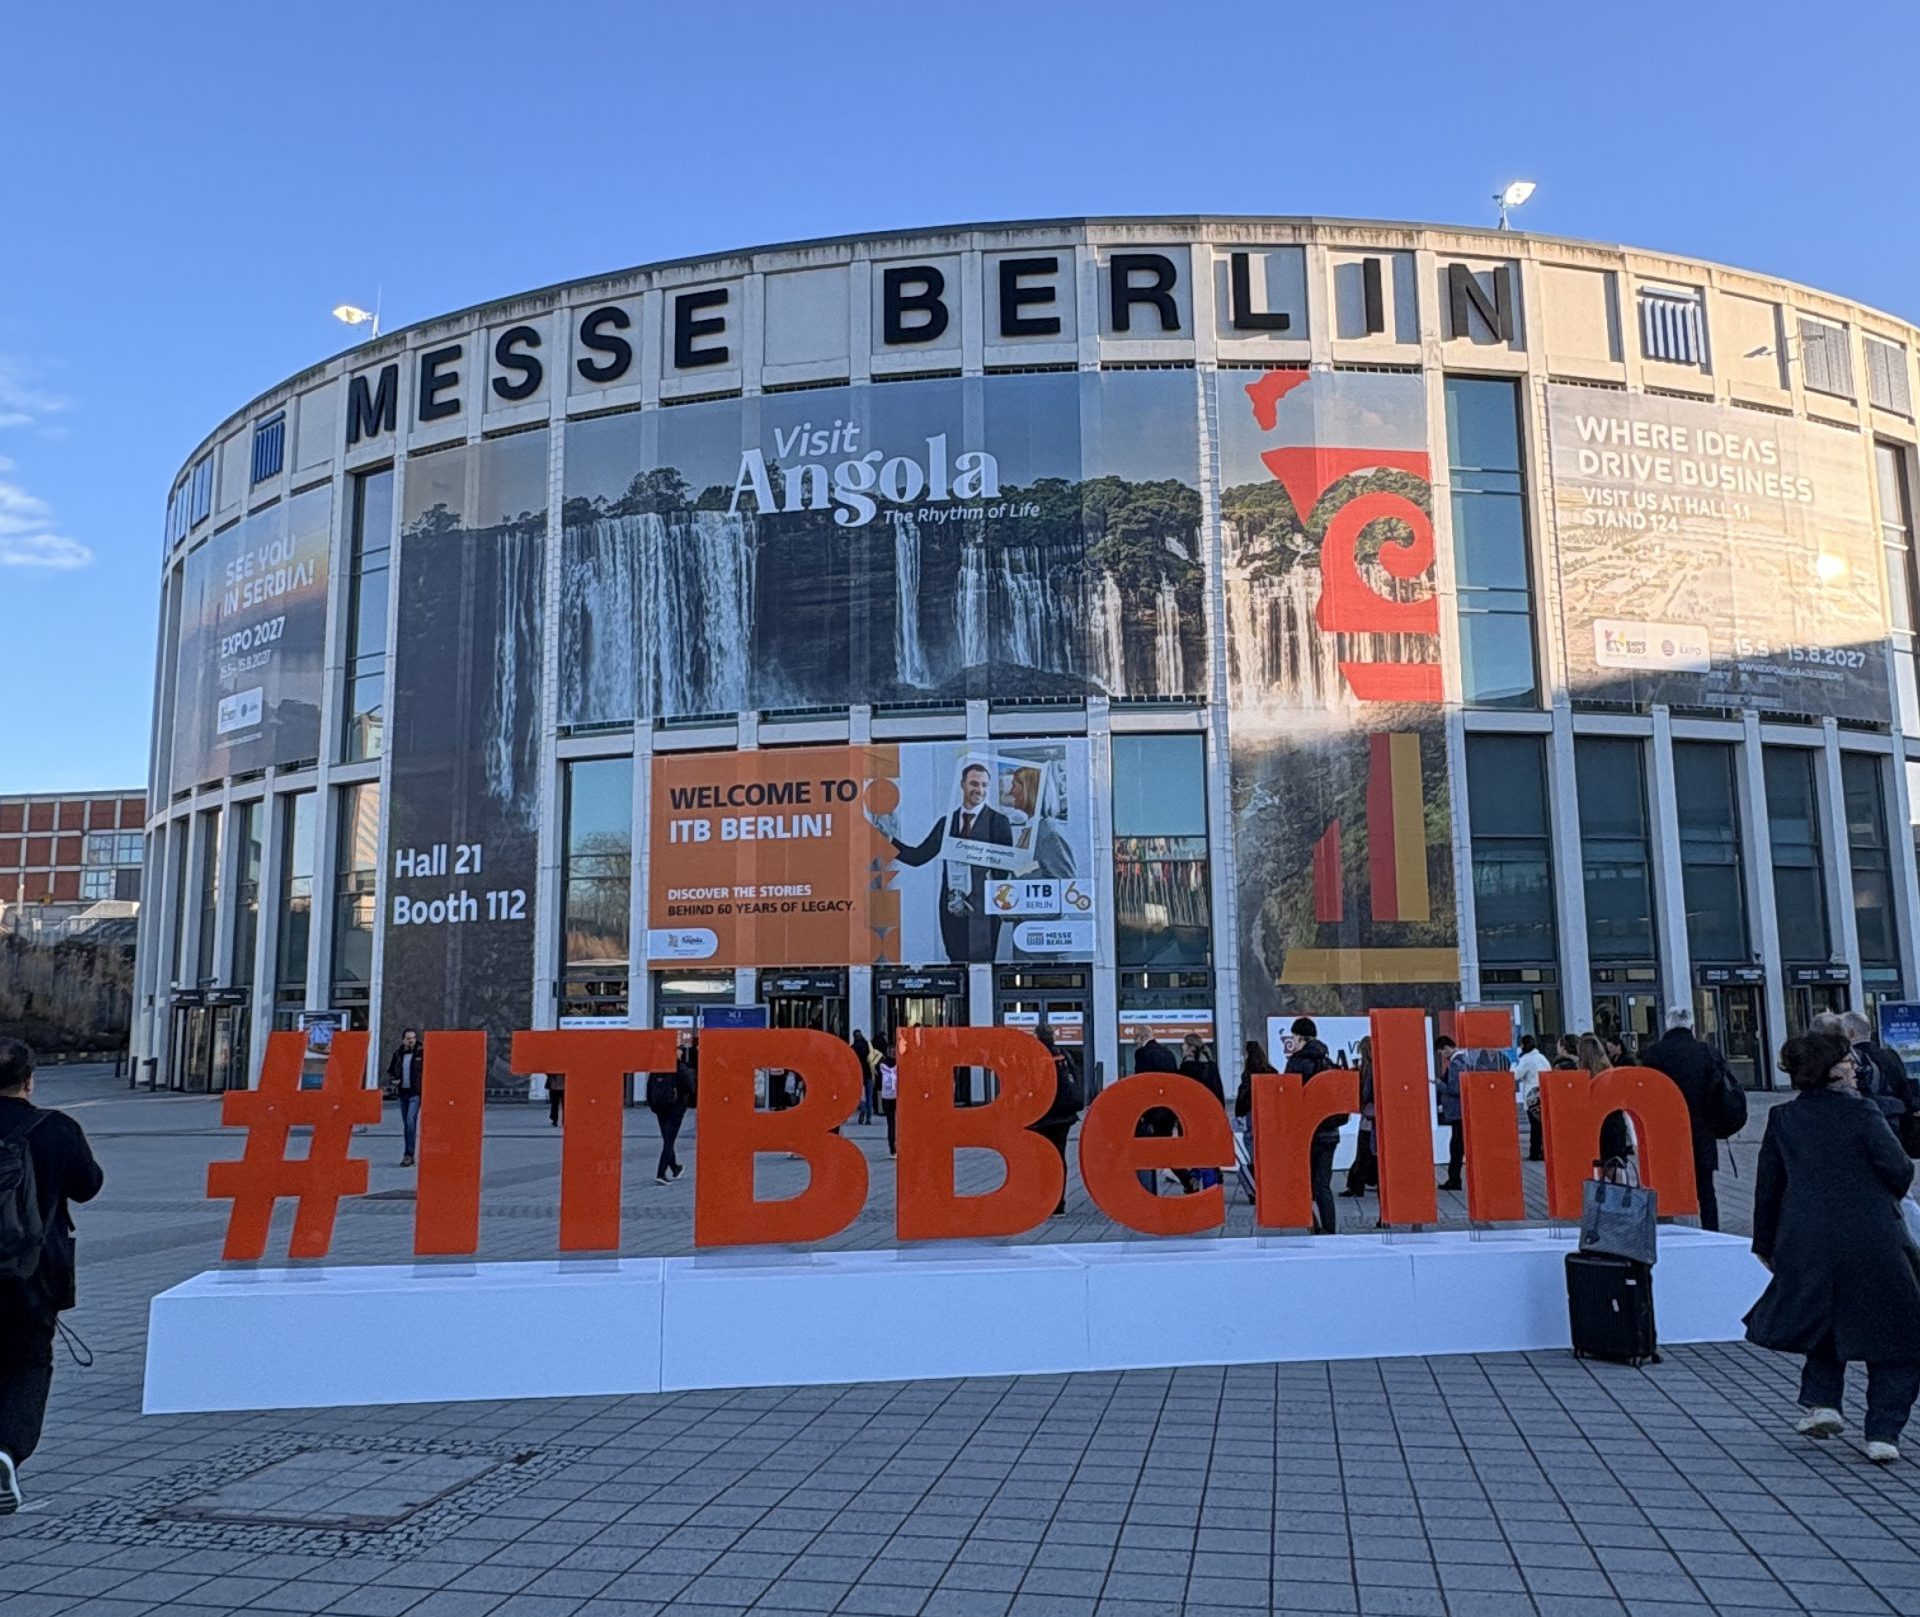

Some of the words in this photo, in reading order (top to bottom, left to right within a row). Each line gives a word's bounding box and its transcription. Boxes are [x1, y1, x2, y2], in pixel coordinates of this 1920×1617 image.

[346, 288, 729, 443] MESSE
[883, 253, 1514, 346] BERLIN
[773, 419, 860, 458] Visit
[1575, 414, 1689, 453] WHERE
[1697, 429, 1778, 465] IDEAS
[727, 433, 1002, 527] Angola
[1578, 450, 1673, 484] DRIVE
[1681, 461, 1813, 503] BUSINESS
[883, 509, 913, 525] The
[918, 505, 983, 525] Rhythm
[988, 504, 1006, 520] of
[1009, 502, 1041, 518] Life
[1582, 486, 1630, 507] VISIT
[1633, 490, 1657, 511] US
[1661, 494, 1683, 514] AT
[1685, 497, 1731, 520] HALL
[1583, 509, 1646, 531] STAND
[1650, 513, 1679, 533] 124
[226, 552, 254, 587] SEE
[260, 534, 295, 572] YOU
[224, 585, 239, 617] IN
[243, 559, 314, 609] SERBIA!
[221, 627, 252, 659] EXPO
[253, 616, 285, 646] 2027
[1786, 641, 1865, 668] 15.8.2027
[670, 781, 811, 811] WELCOME
[820, 779, 858, 803] TO
[670, 816, 711, 843] ITB
[721, 813, 832, 841] BERLIN!
[395, 844, 447, 878] Hall
[454, 844, 482, 875] 21
[393, 890, 478, 925] Booth
[486, 889, 527, 921] 112
[667, 886, 730, 901] DISCOVER
[732, 885, 757, 899] THE
[760, 884, 812, 898] STORIES
[668, 904, 714, 917] BEHIND
[717, 903, 732, 915] 60
[736, 902, 777, 915] YEARS
[779, 901, 798, 914] OF
[801, 899, 857, 913] LEGACY.
[1026, 884, 1053, 898] ITB
[207, 1008, 1699, 1261] #ITBBerlin
